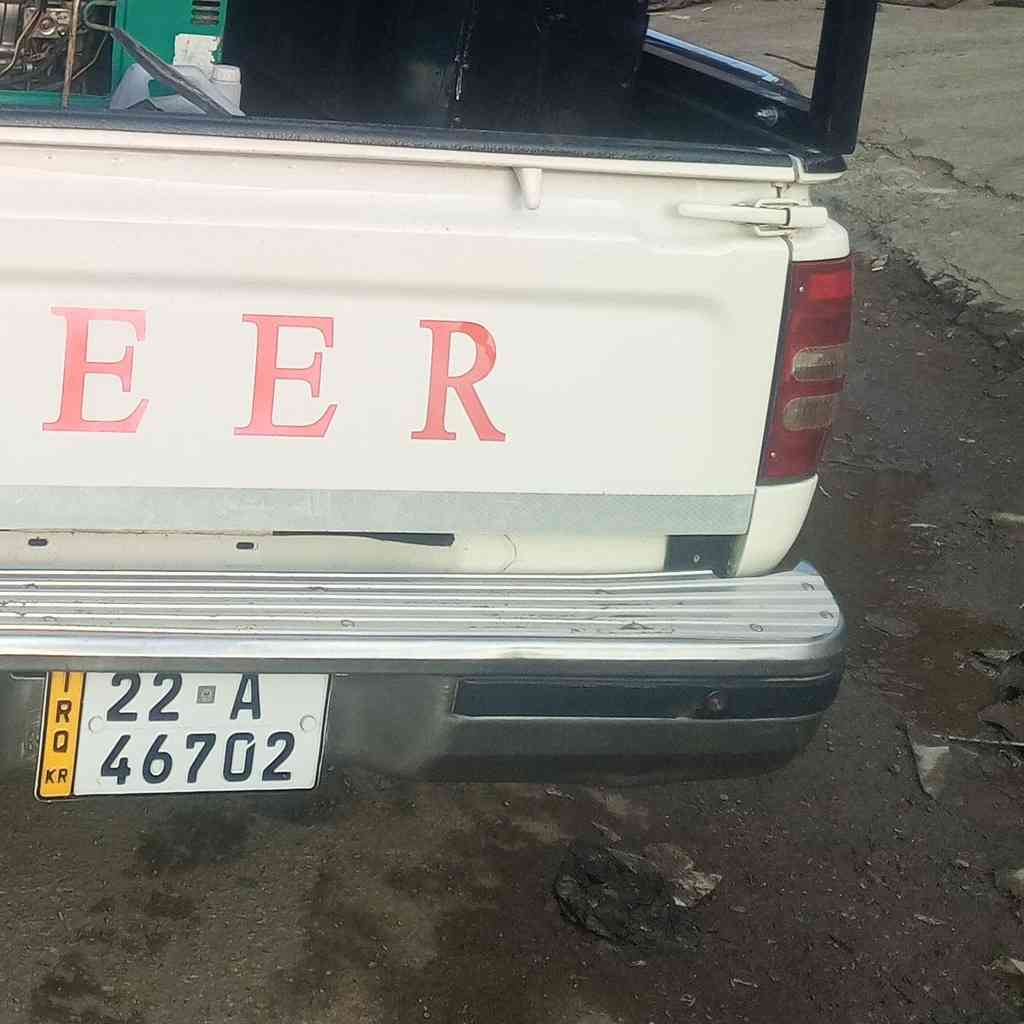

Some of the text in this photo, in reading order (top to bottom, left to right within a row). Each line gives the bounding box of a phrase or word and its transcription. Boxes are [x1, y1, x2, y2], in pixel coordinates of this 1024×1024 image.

[106, 673, 261, 721] 22 A
[45, 768, 68, 784] KR
[100, 732, 295, 785] 46702
